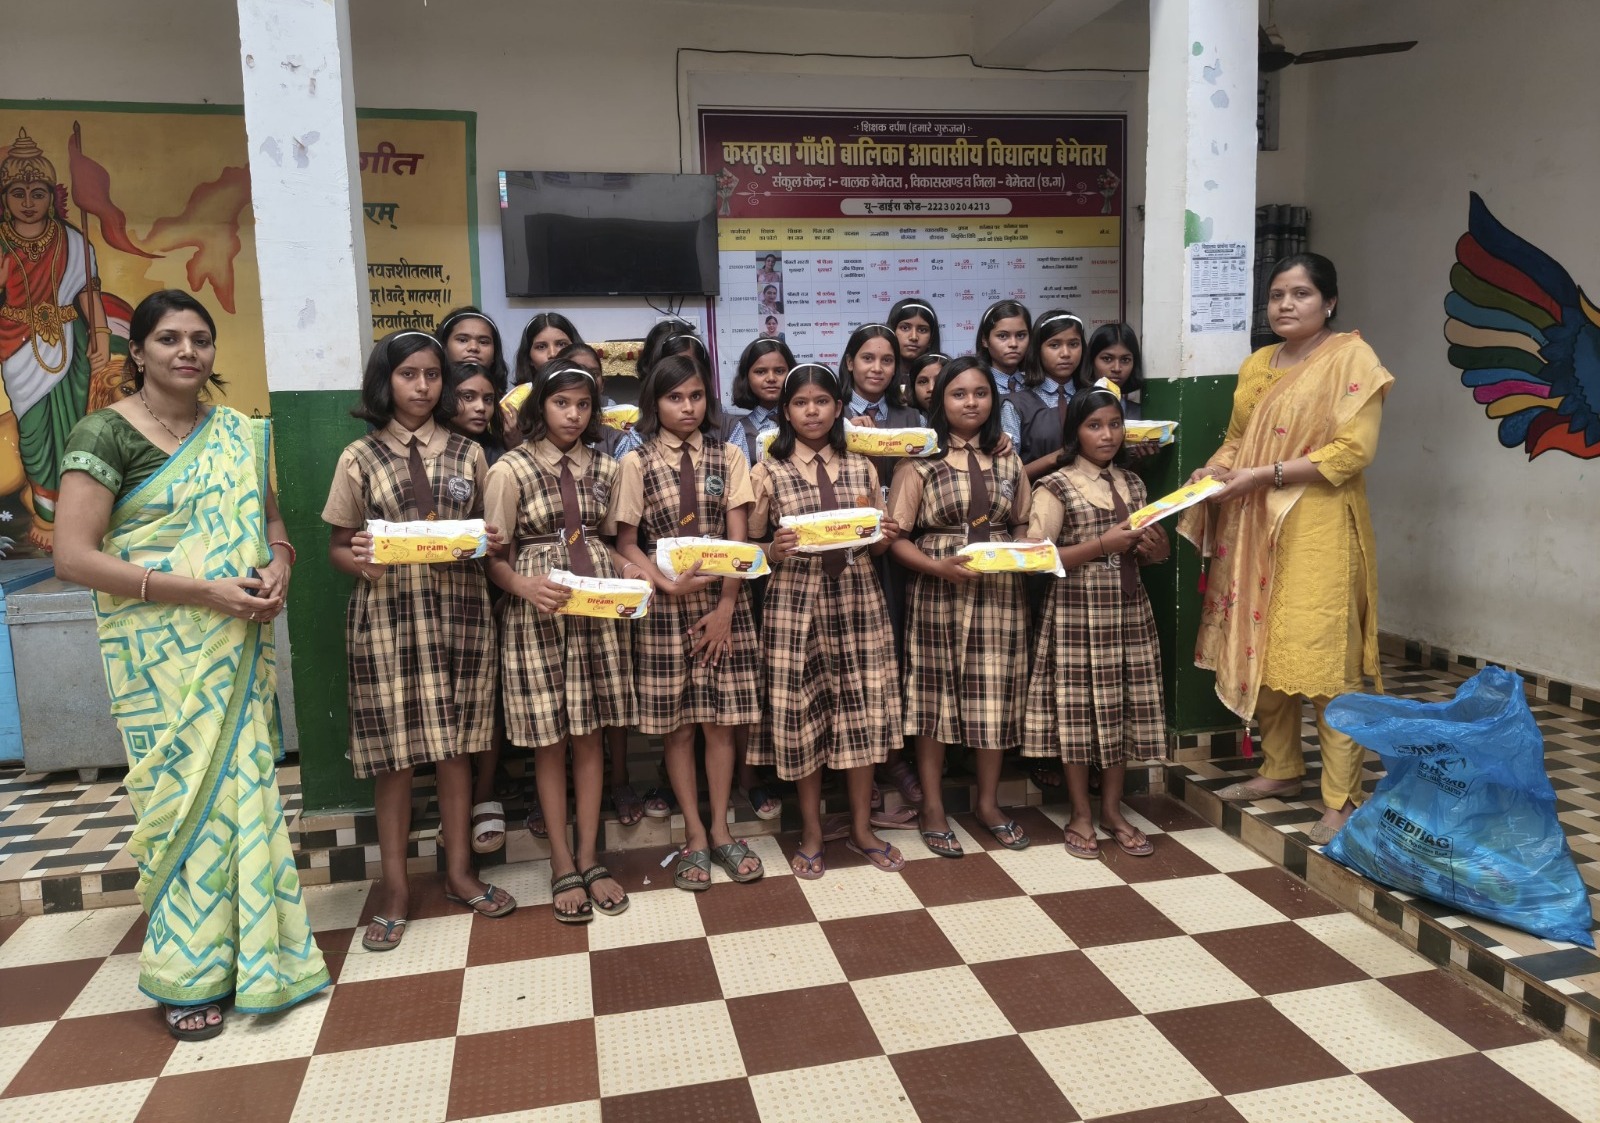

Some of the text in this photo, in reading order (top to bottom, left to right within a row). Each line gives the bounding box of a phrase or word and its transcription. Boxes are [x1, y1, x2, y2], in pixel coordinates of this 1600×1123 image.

[861, 121, 887, 132] शिक्षक
[889, 122, 906, 132] दर्पण
[908, 122, 932, 133] (हमारे
[722, 141, 792, 174] कस्तूरबा
[840, 136, 906, 166] बालिका
[908, 138, 984, 166] आवासीय
[986, 138, 1053, 166] विद्यालय
[1055, 138, 1108, 166] बेमेतरा
[772, 172, 801, 191] संकुल
[803, 173, 826, 188] केन्द्र
[840, 175, 869, 188] बालक
[910, 173, 963, 188] विकासखण्ड
[973, 173, 996, 188] जिला
[1005, 174, 1036, 188] बेमेतरा
[363, 203, 400, 230] रम्
[878, 440, 902, 448] Dreams
[825, 523, 851, 533] Dreams
[417, 544, 448, 552] Dreams
[587, 597, 614, 605] Dreams
